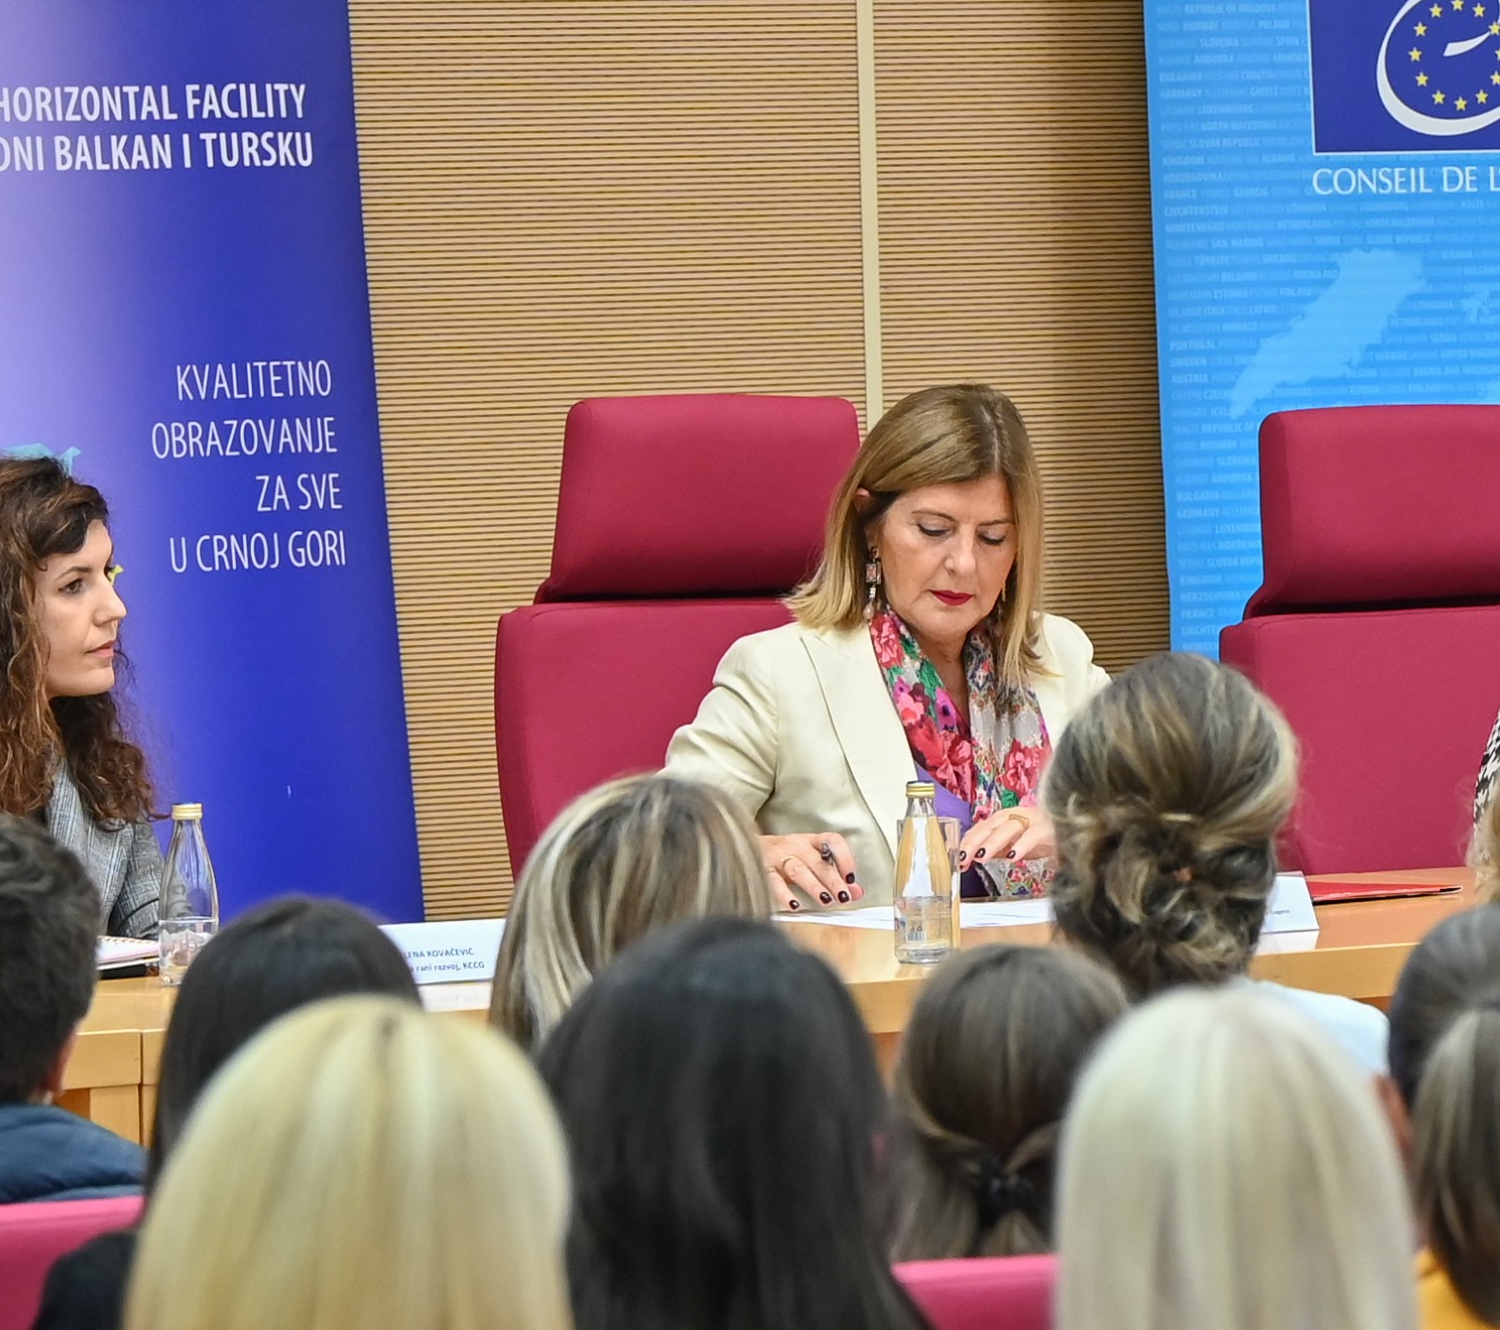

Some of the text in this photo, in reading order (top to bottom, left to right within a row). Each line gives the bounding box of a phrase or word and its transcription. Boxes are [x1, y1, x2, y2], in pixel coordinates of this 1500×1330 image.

[185, 83, 306, 119] FACILITY
[54, 134, 172, 171] BALKAN
[182, 133, 191, 168] I
[199, 132, 313, 168] TURSKU
[1312, 167, 1433, 195] CONSEIL
[1442, 166, 1478, 193] DE
[177, 360, 331, 400] KVALITETNO
[152, 417, 337, 459] OBRAZOVANJE
[256, 473, 343, 511] ZA SVE
[170, 530, 346, 573] U CRNOJ GORI
[404, 951, 425, 959] LENA
